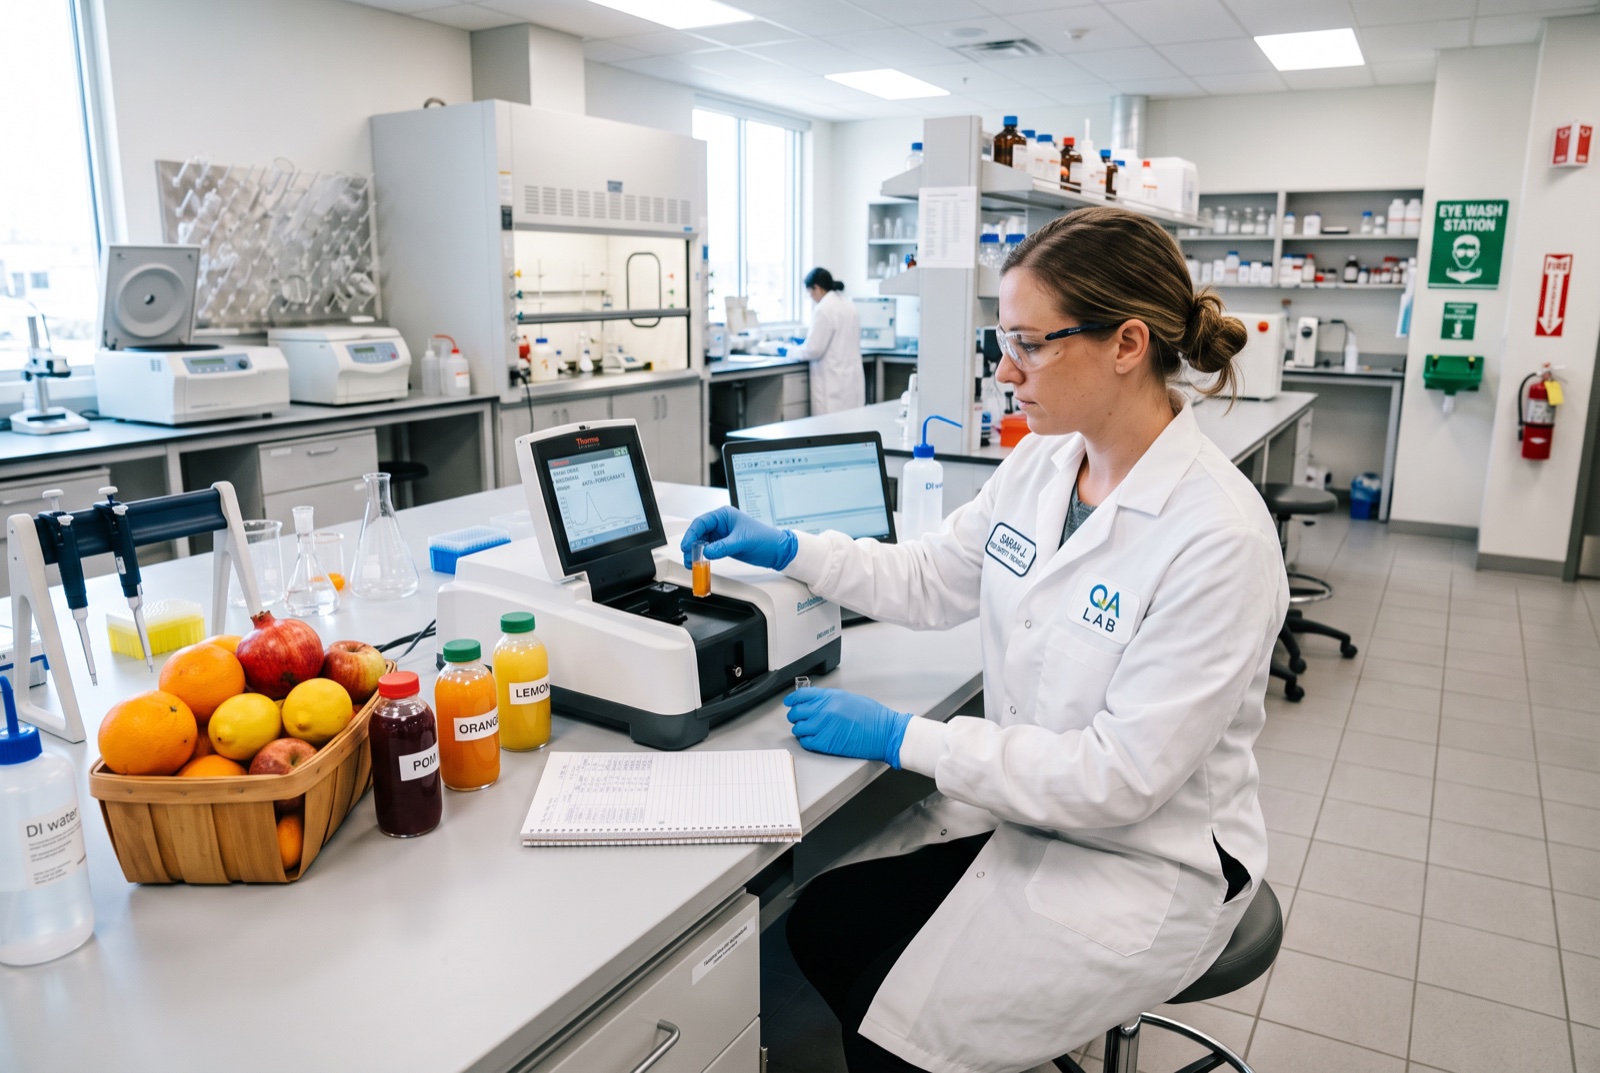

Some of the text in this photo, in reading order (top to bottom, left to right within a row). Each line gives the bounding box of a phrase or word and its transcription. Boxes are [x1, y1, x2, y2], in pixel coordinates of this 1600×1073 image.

[1439, 204, 1503, 218] EYE WASH
[1443, 218, 1496, 232] STATION
[1548, 262, 1567, 270] FIRE
[925, 482, 934, 490] DI
[1000, 533, 1027, 558] SARAH J.
[1089, 584, 1120, 619] QA
[1082, 607, 1116, 633] LAB
[515, 682, 550, 698] LEMON
[413, 752, 437, 771] POM
[26, 822, 43, 838] DI
[47, 807, 78, 832] water
